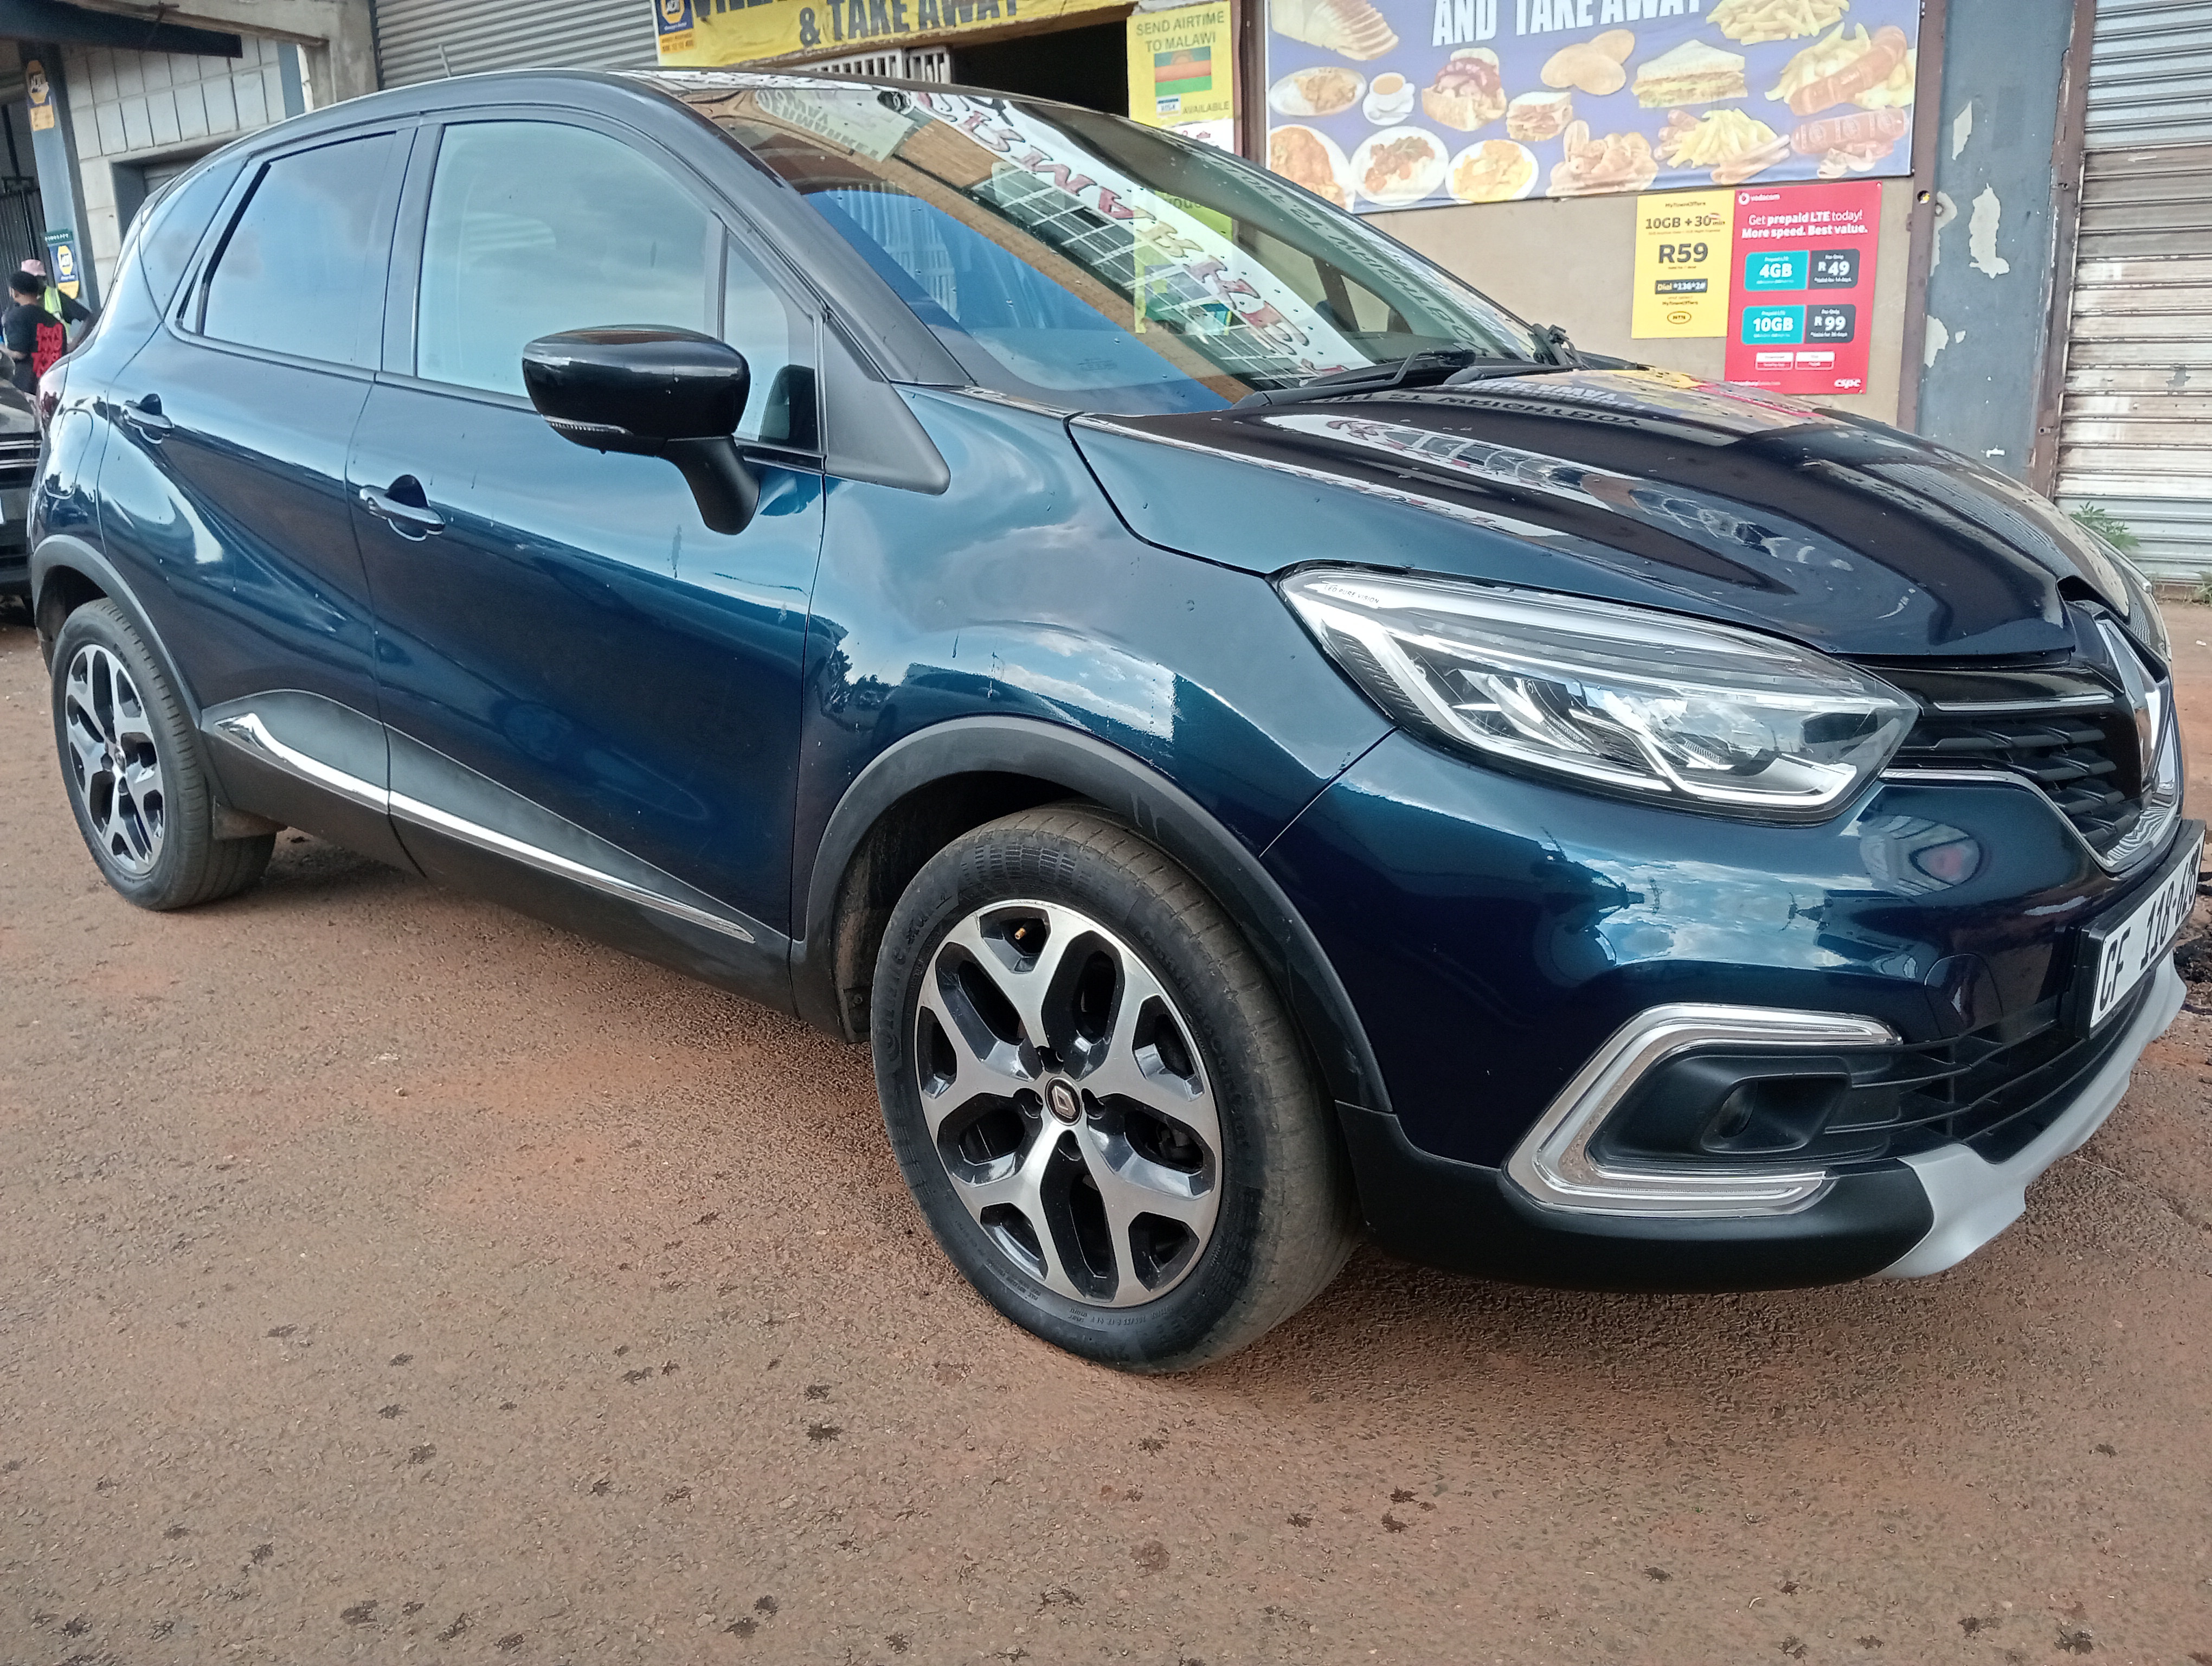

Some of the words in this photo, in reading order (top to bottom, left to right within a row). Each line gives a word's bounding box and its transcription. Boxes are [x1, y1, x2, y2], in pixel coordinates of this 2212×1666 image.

[800, 7, 821, 47] &
[1136, 20, 1170, 36] SEND
[1173, 11, 1224, 31] AIRTIME
[1432, 0, 1497, 47] AND
[1146, 40, 1162, 52] TO
[1166, 31, 1216, 49] MALAWI
[1182, 101, 1230, 114] AVAILABLE
[1751, 193, 1780, 201] vodacom
[1645, 217, 1681, 229] 10GB
[1748, 214, 1766, 225] Get
[1767, 212, 1809, 226] prepaid
[1810, 211, 1830, 222] LTE
[1831, 209, 1863, 223] today!
[1741, 228, 1770, 239] More
[1771, 226, 1806, 239] speed.
[1808, 225, 1832, 236] Best
[1834, 223, 1868, 234] value.
[1658, 242, 1708, 264] R59
[1759, 263, 1792, 278] 4GB
[1818, 261, 1827, 272] R
[1828, 261, 1850, 276] 49
[1753, 317, 1793, 332] 10GB
[1814, 316, 1822, 326] R
[1825, 316, 1846, 331] 99
[1324, 585, 1337, 594] LED
[1339, 587, 1356, 597] PURE
[1358, 594, 1380, 604] VISION
[2100, 926, 2131, 1011] CF
